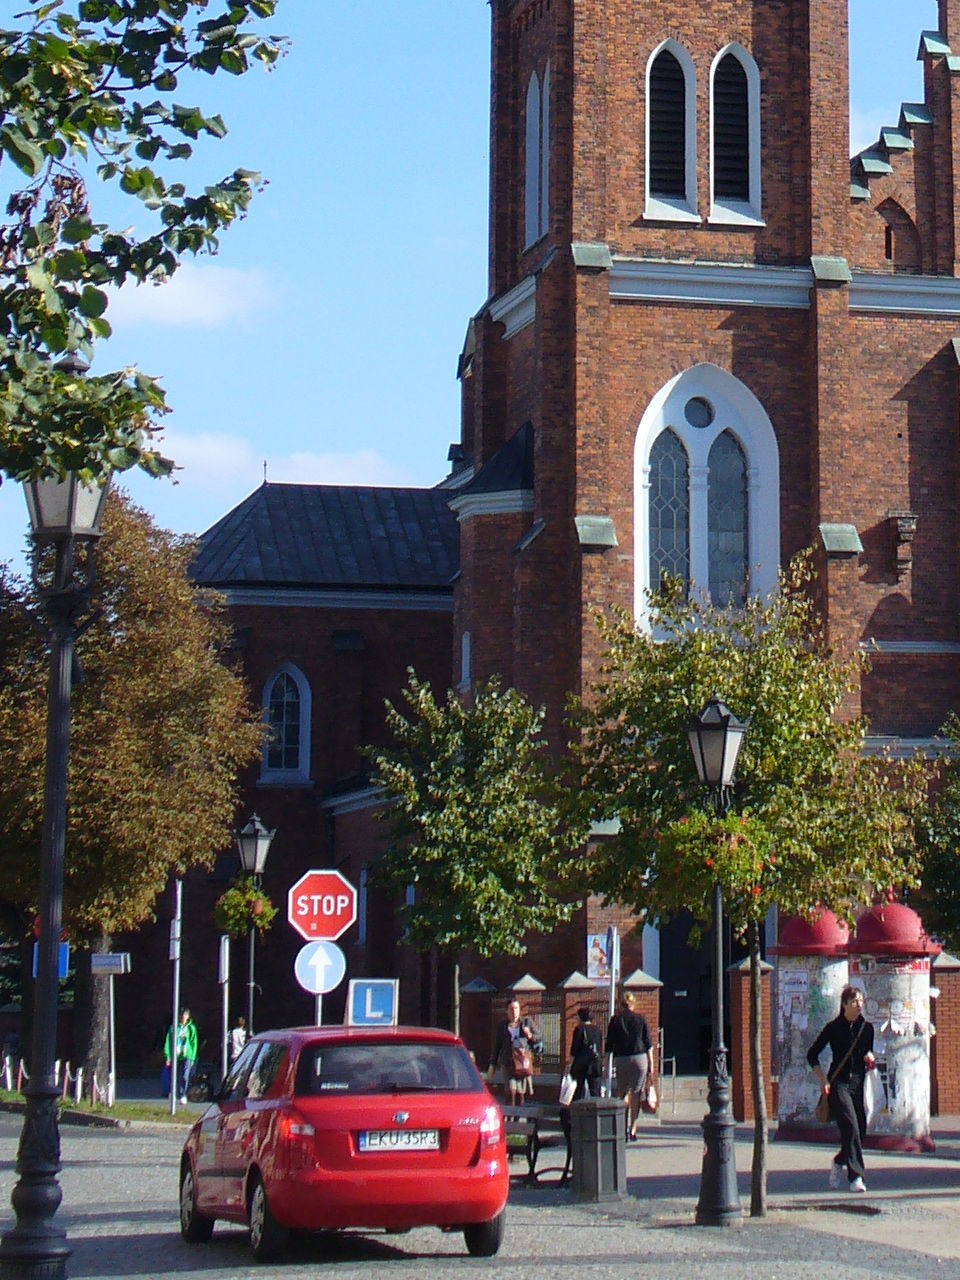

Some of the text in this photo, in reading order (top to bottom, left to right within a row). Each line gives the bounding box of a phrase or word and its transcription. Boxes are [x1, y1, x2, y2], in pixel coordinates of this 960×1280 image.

[297, 895, 349, 915] STOP
[365, 988, 384, 1018] L
[368, 1131, 399, 1146] EKU
